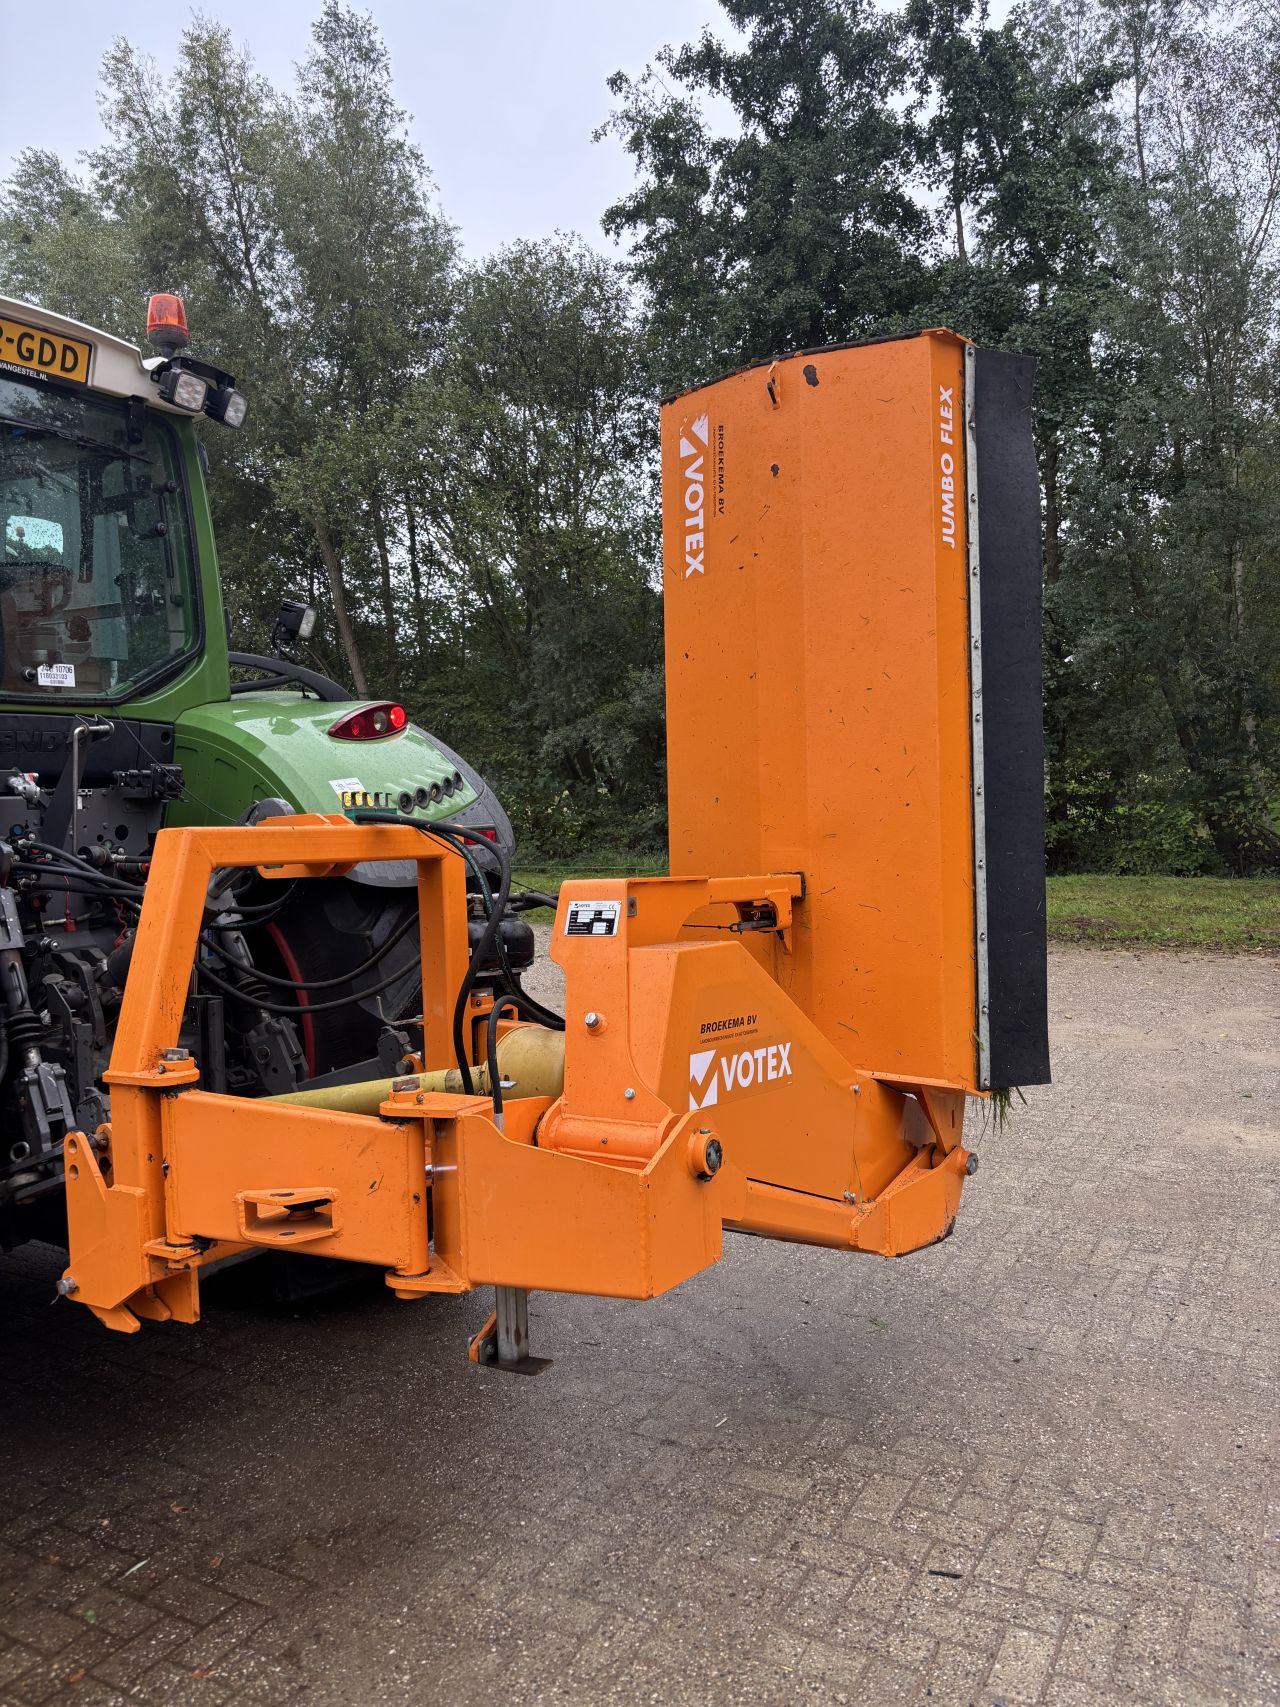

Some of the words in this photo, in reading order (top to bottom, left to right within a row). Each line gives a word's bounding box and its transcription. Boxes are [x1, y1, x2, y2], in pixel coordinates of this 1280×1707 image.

[0, 325, 78, 373] -GDD
[939, 384, 953, 445] FLEX
[684, 455, 704, 579] VOTEX
[719, 498, 725, 514] BV
[940, 453, 955, 549] JUMBO
[700, 1016, 745, 1034] BROEKEMA
[747, 1014, 757, 1025] BV
[720, 1042, 792, 1091] VOTEX
